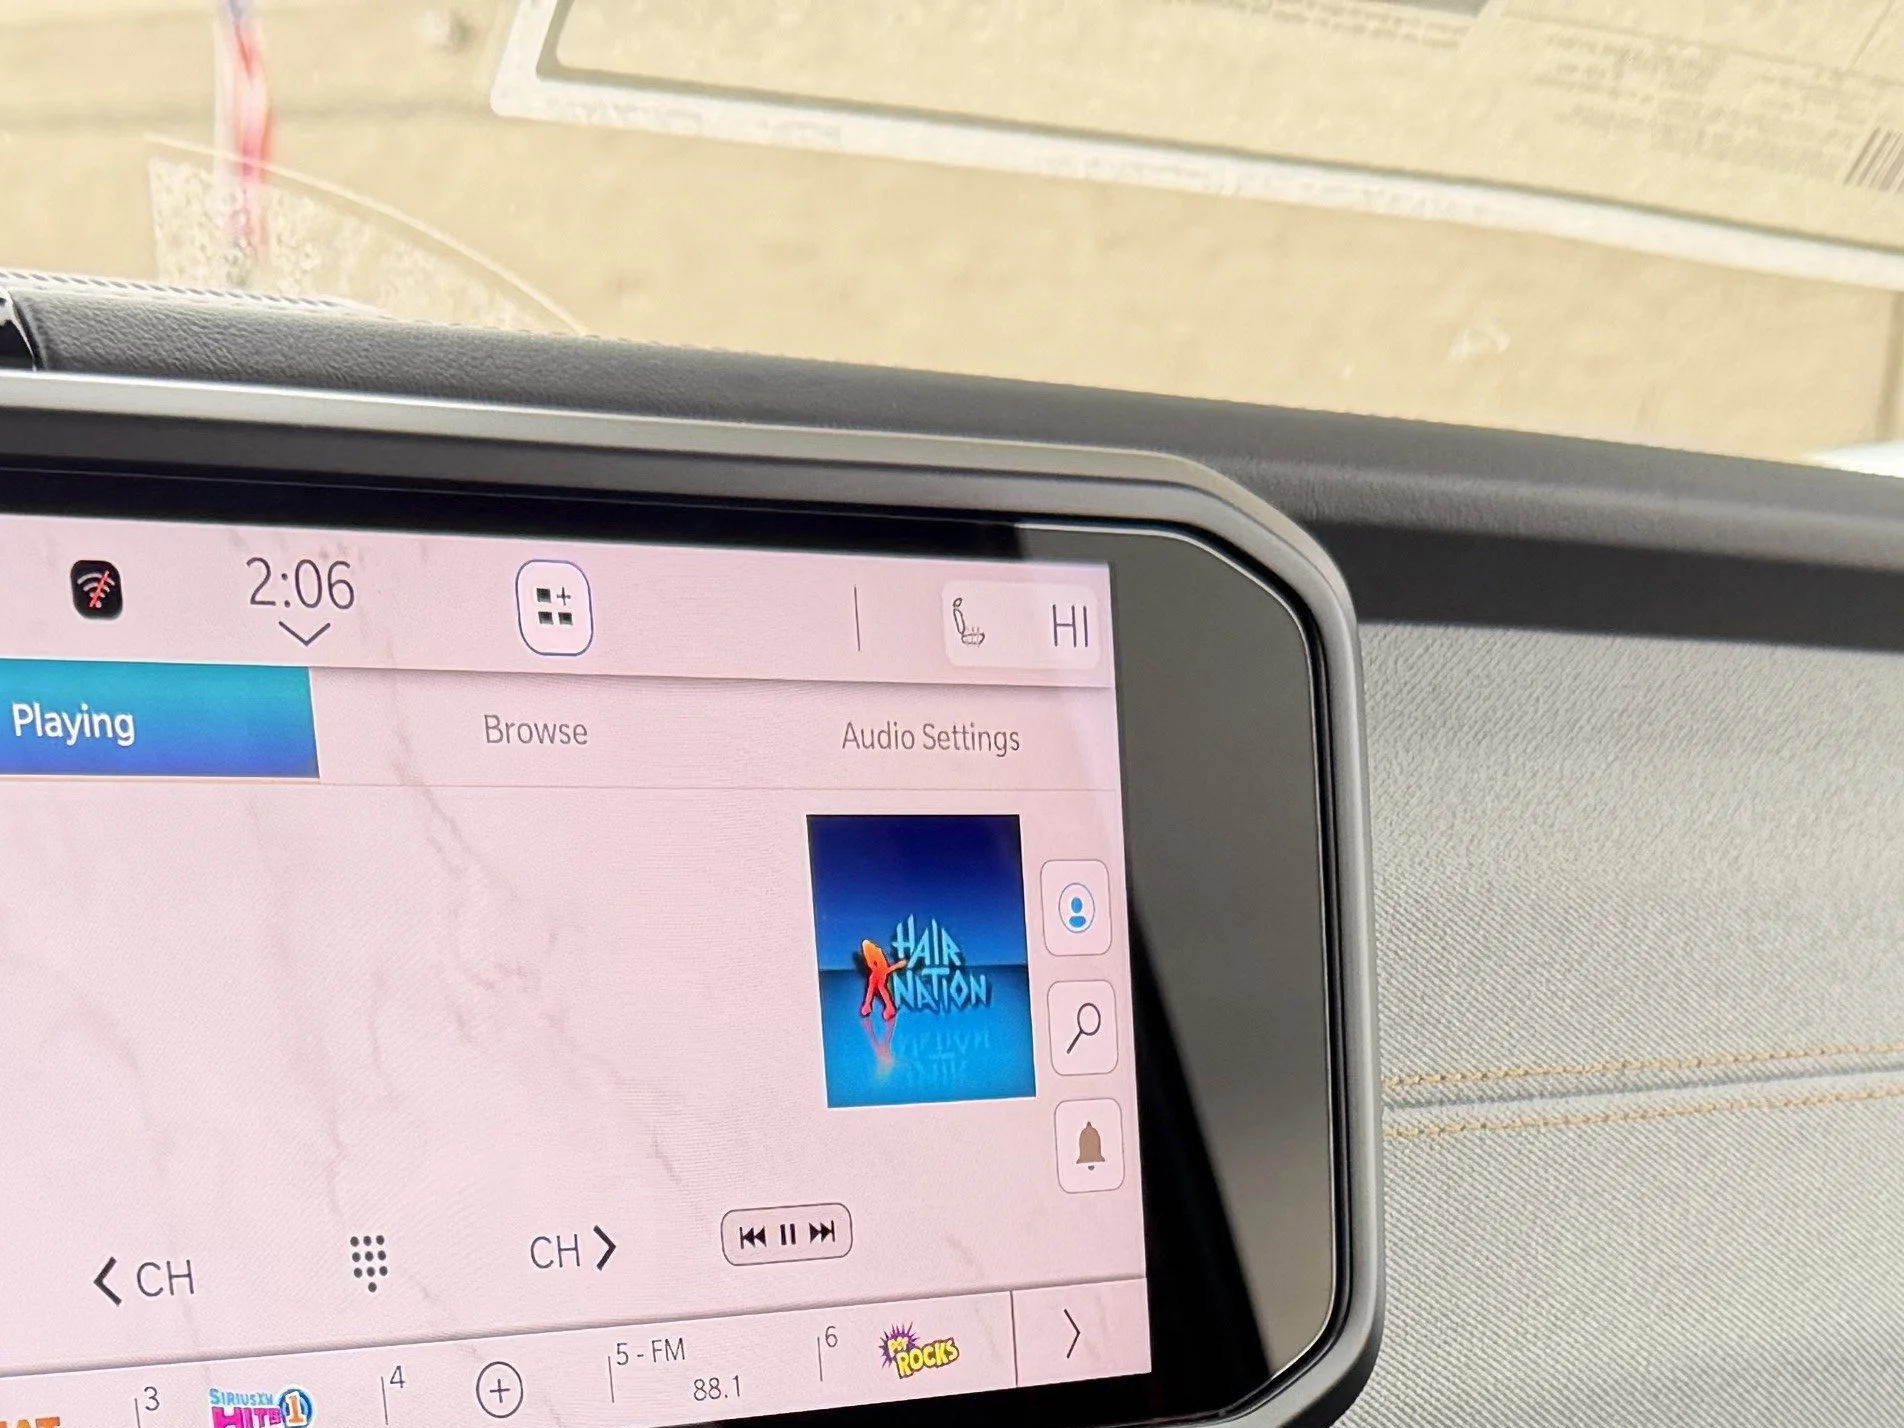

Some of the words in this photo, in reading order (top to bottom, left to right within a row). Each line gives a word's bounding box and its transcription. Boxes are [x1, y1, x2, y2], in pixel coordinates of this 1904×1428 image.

[245, 556, 356, 611] 2:06
[1051, 602, 1090, 649] HI
[11, 701, 136, 746] Playing
[483, 713, 589, 746] Browse
[841, 721, 916, 752] Audio
[921, 723, 1021, 758] Settings
[890, 912, 964, 968] HAIR
[893, 964, 992, 1013] NATION
[529, 1233, 581, 1270] CH
[135, 1259, 197, 1299] CH
[615, 1342, 630, 1366] 5
[651, 1337, 687, 1363] FM
[824, 1325, 839, 1349] 6
[895, 1339, 959, 1378] ROCKS
[388, 1365, 406, 1391] 4
[693, 1375, 742, 1402] 88.1
[143, 1386, 161, 1412] 3
